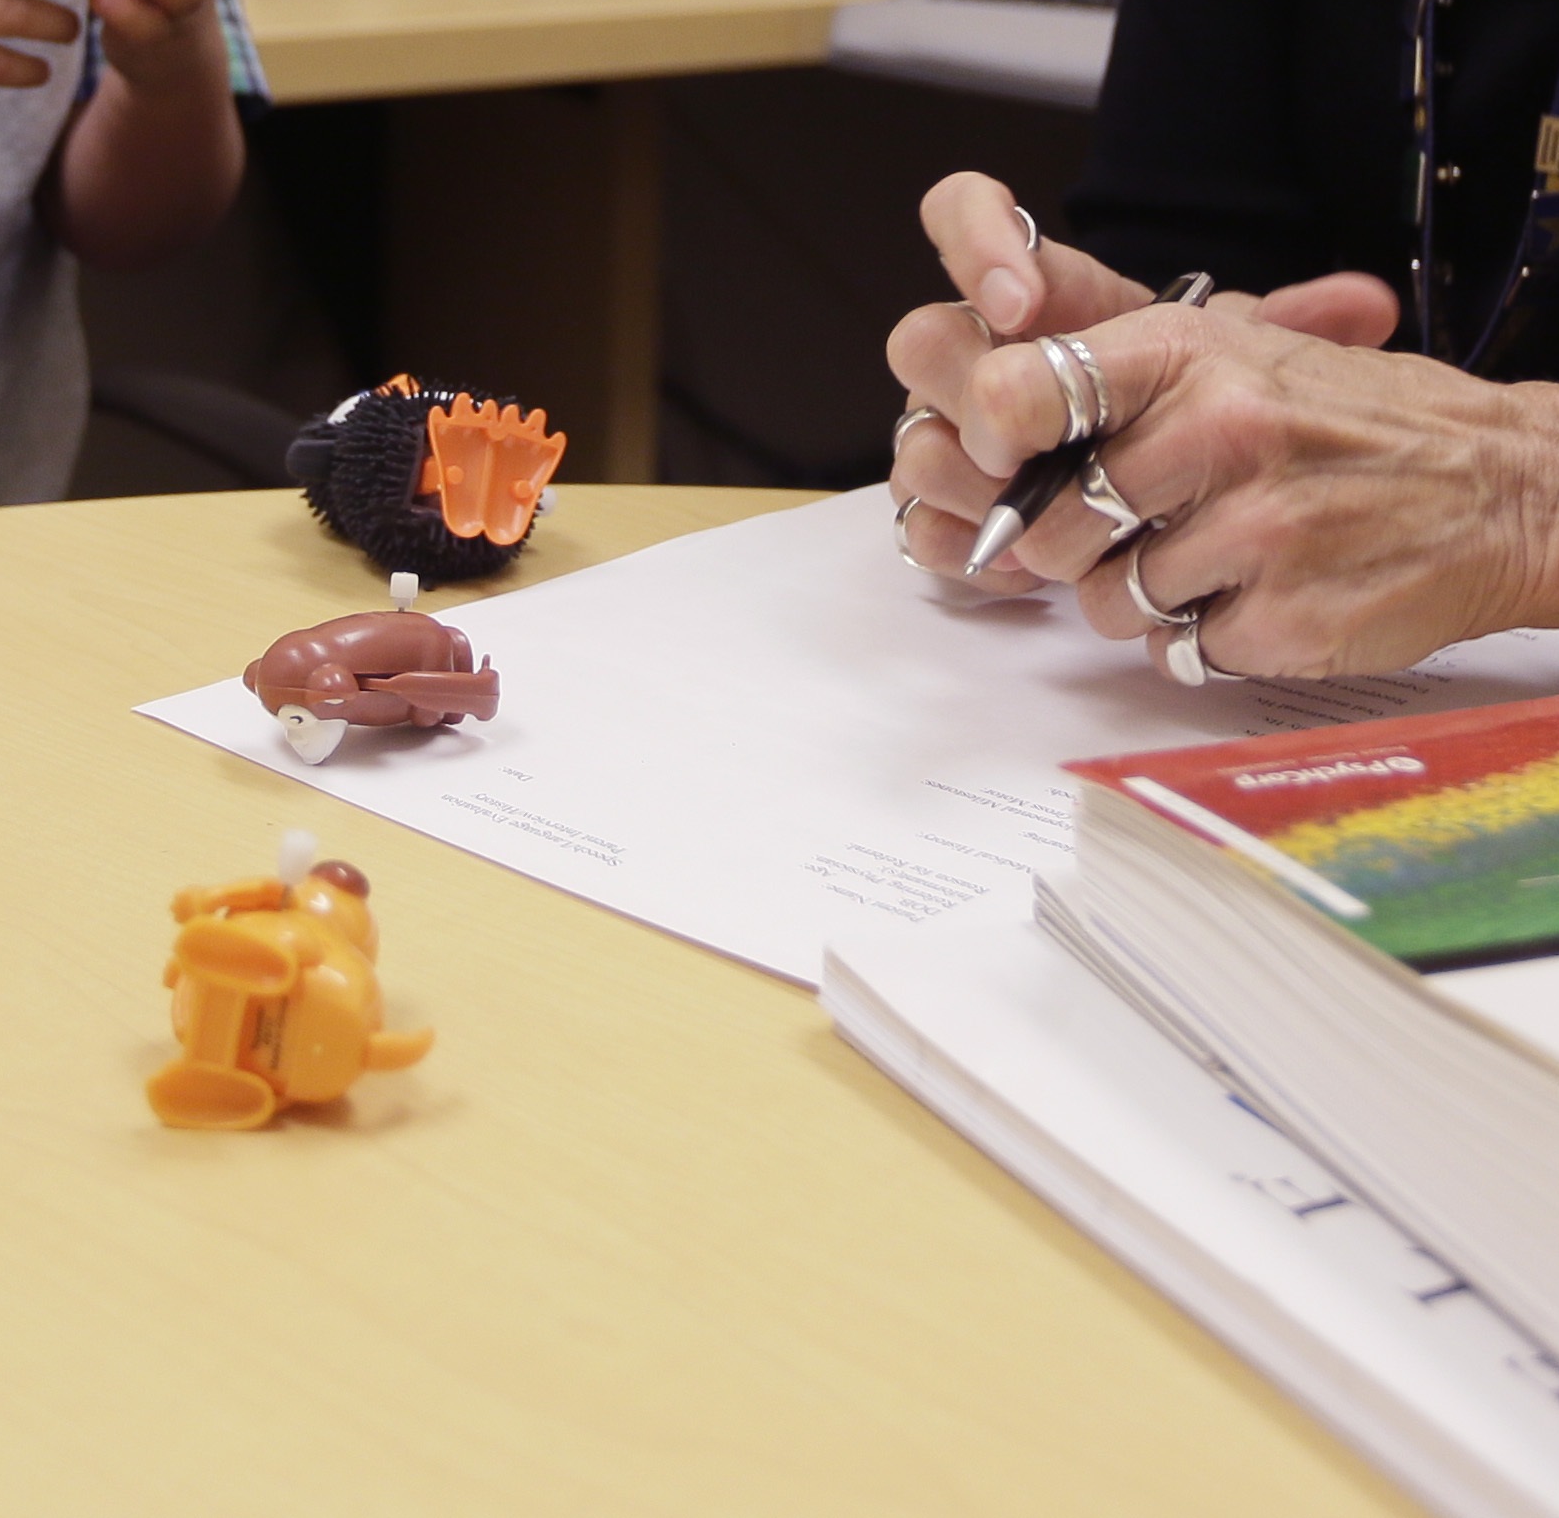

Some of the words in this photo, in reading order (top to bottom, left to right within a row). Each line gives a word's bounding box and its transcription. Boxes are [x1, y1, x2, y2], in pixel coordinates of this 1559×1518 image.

[498, 766, 533, 782] Date:
[1234, 760, 1391, 789] PsychCorp
[920, 779, 998, 809] Milestones:
[441, 793, 508, 824] Evaluation
[584, 834, 626, 854] Parent
[911, 864, 934, 875] for
[974, 850, 1033, 874] Medical
[888, 881, 958, 909] Referring
[936, 872, 990, 894] Reason
